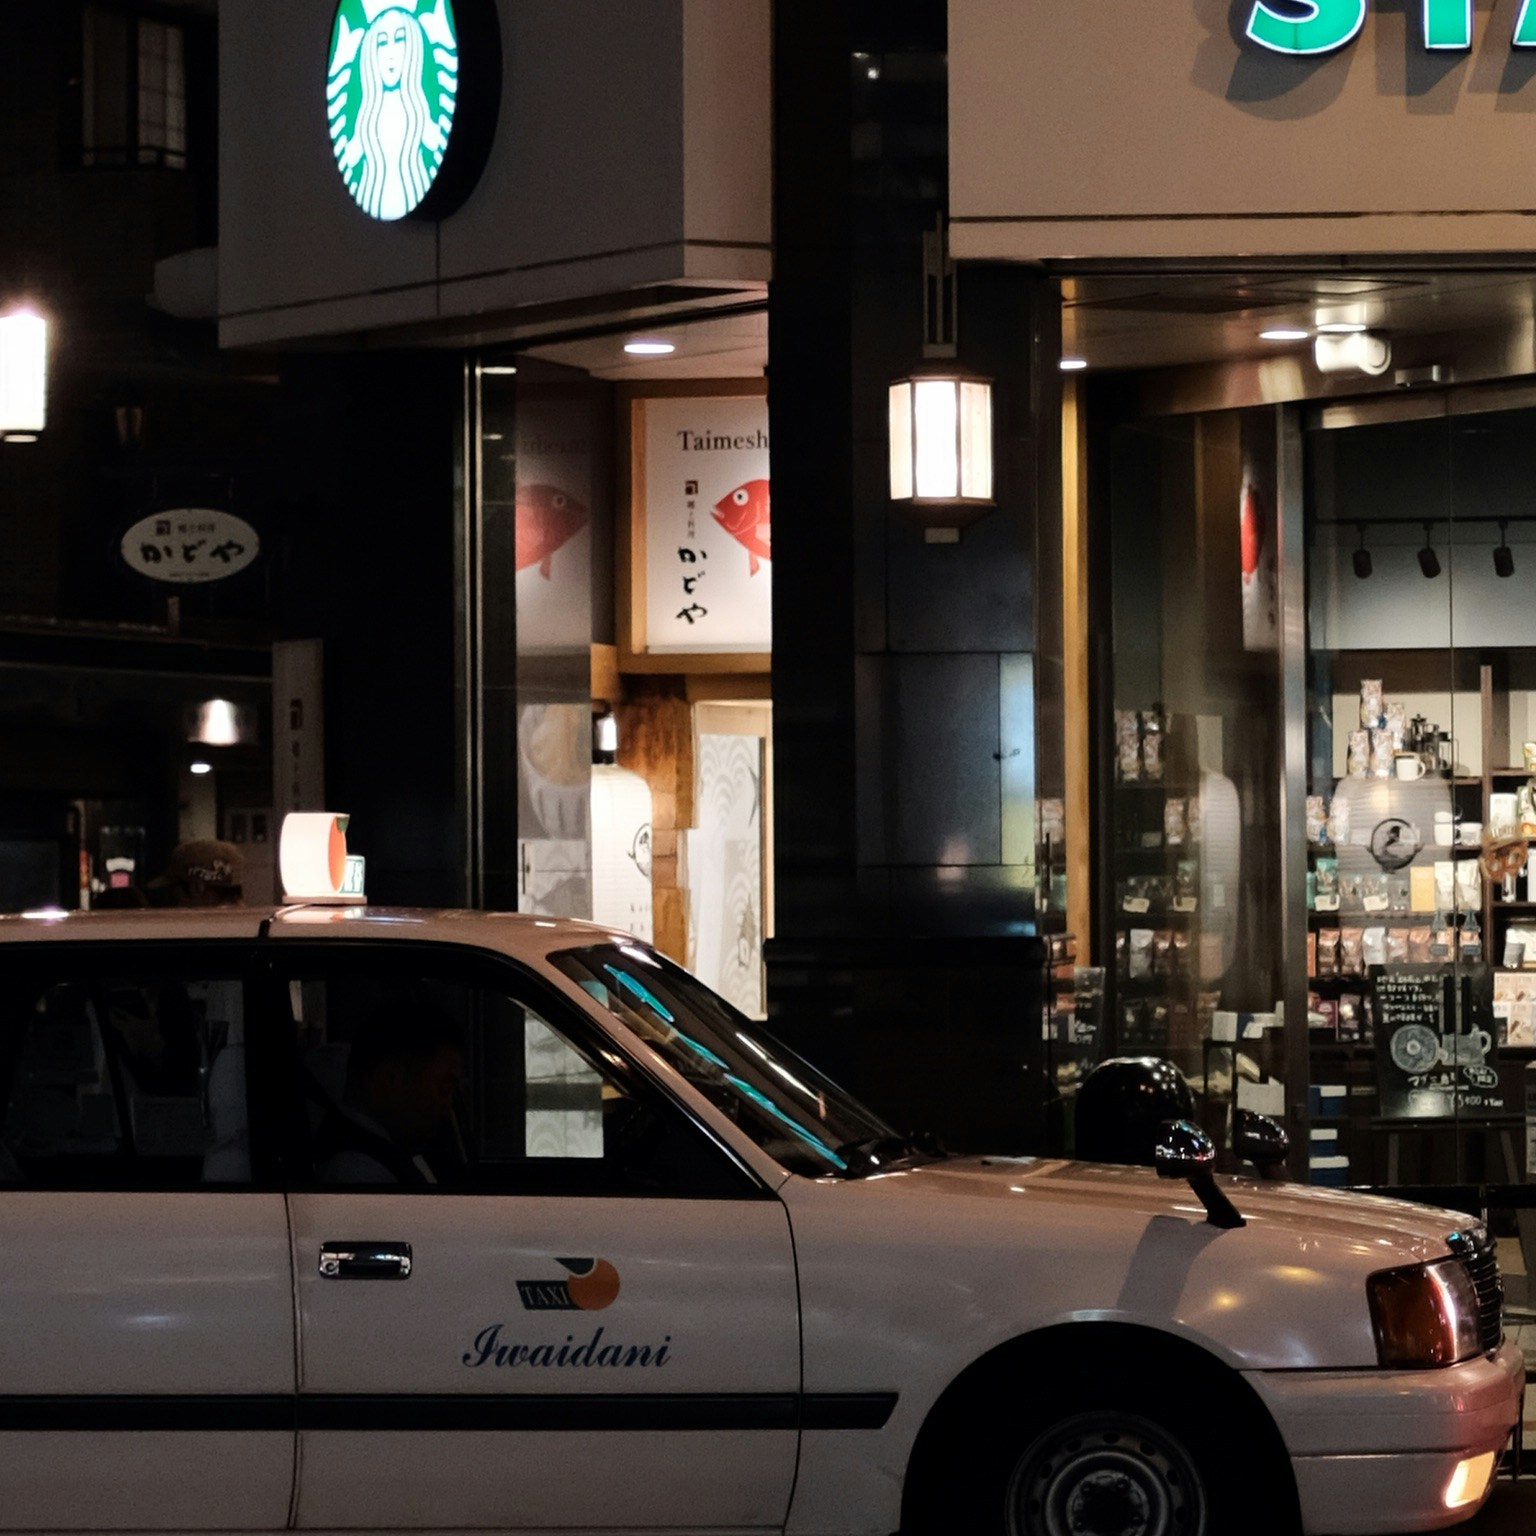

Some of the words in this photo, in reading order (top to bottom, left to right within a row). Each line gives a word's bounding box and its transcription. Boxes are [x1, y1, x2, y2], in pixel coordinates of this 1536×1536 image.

[140, 539, 245, 564] かどや
[675, 546, 708, 626] かどや
[520, 1286, 571, 1306] TAXI
[462, 1322, 672, 1371] Iwaidani
